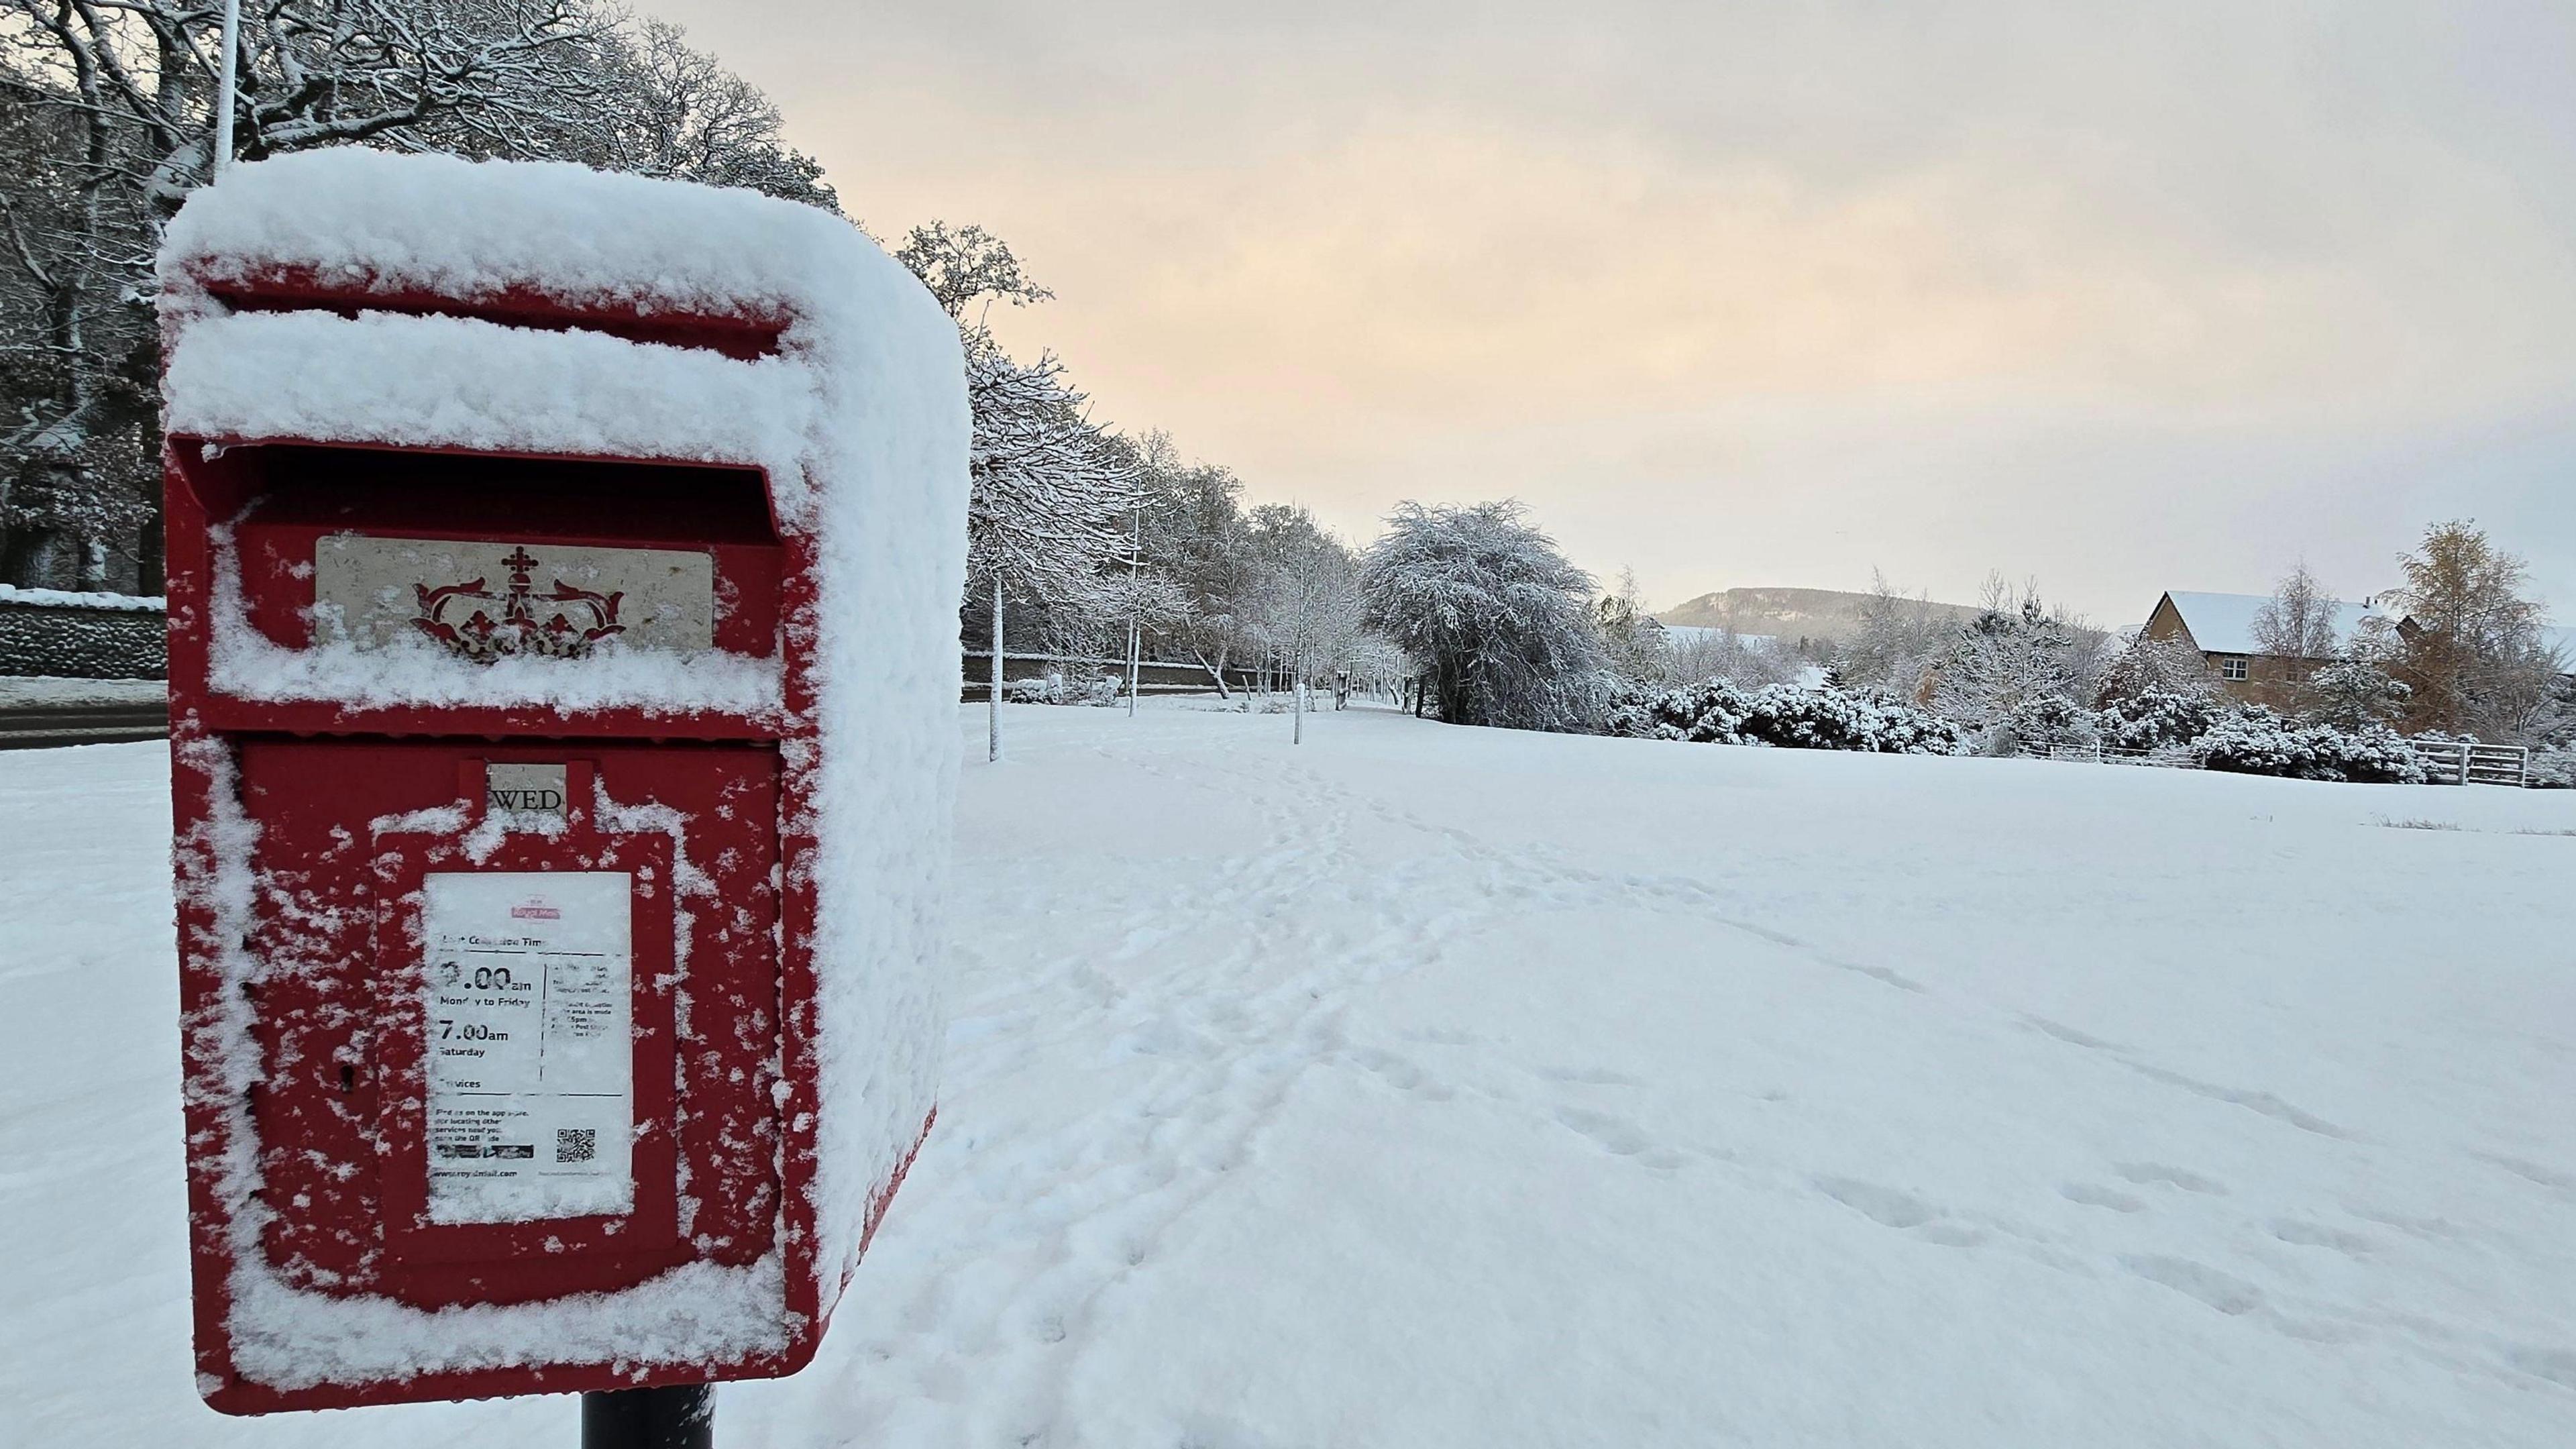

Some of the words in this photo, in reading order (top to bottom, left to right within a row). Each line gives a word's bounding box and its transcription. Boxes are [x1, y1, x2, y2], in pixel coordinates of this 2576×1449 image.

[490, 790, 562, 810] WED
[498, 998, 531, 1008] Friday
[439, 1020, 508, 1040] 7.00am
